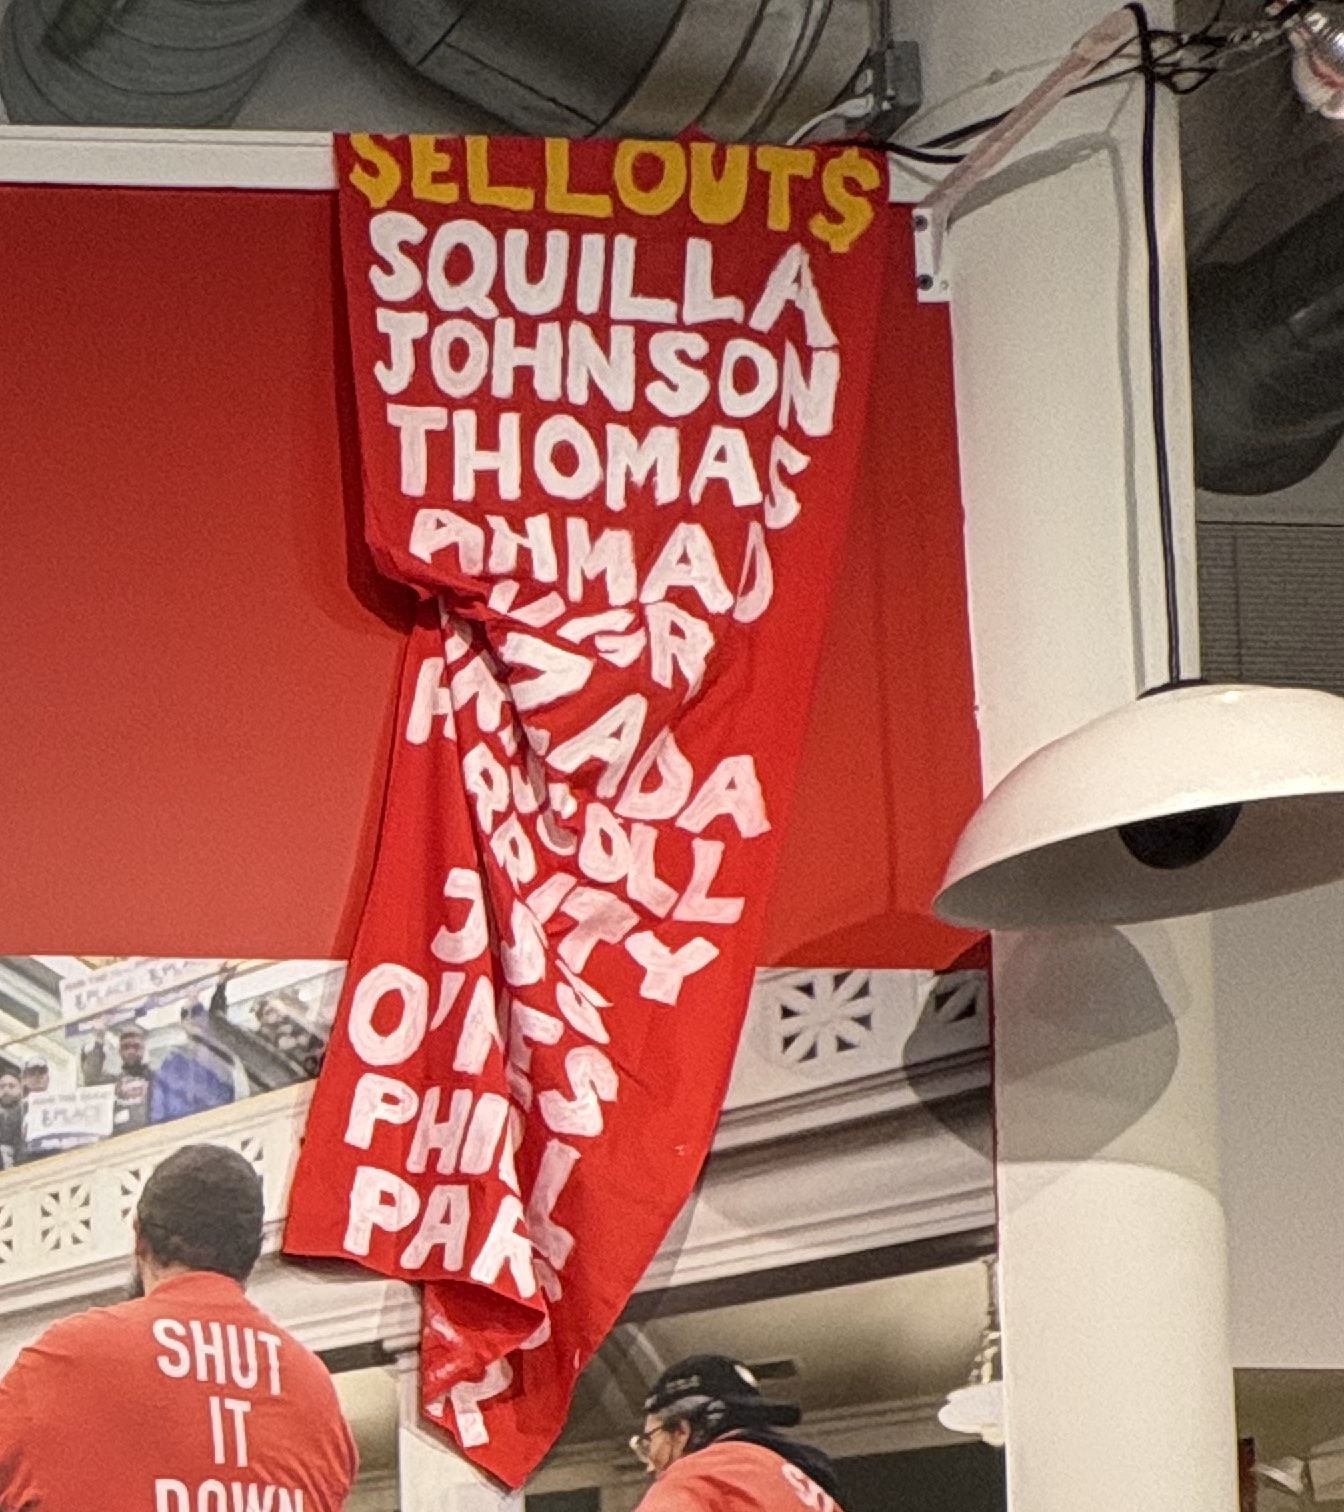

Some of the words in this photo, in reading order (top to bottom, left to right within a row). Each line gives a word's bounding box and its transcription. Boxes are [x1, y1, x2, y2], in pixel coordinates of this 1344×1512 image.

[369, 211, 839, 349] SQUILLA
[374, 308, 839, 436] JOHNSON
[387, 405, 810, 529] THOMAS
[153, 1318, 282, 1396] SHUT
[209, 1396, 251, 1468] IT
